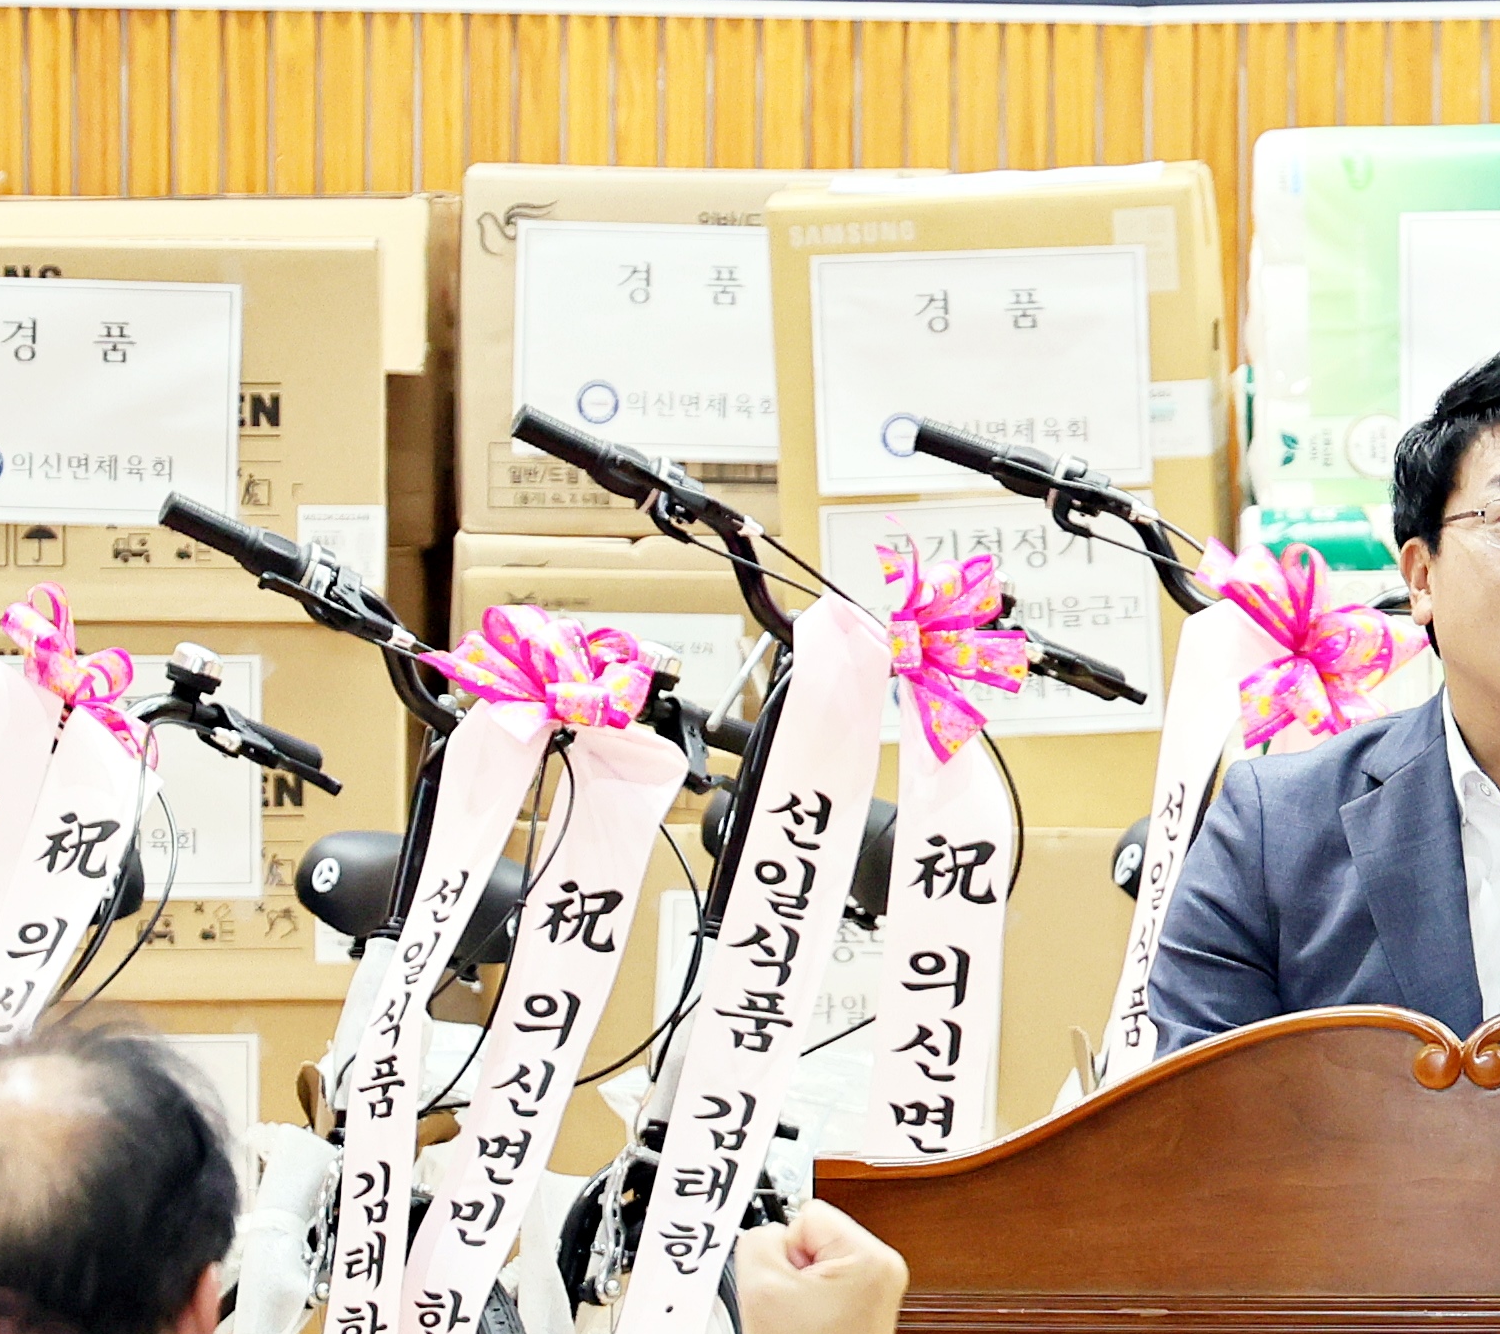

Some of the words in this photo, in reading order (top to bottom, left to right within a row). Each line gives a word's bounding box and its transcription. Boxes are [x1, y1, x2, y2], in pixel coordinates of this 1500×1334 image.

[788, 221, 915, 248] SAMSUNG
[10, 452, 175, 482] 의신면체육회
[34, 810, 122, 880] 祝
[907, 833, 998, 905] 祝
[532, 878, 625, 953] 祝
[713, 788, 833, 1053] 선일식품
[357, 869, 470, 1120] 선일식품
[448, 988, 582, 1248] 의신면민
[658, 1090, 757, 1275] 김태한
